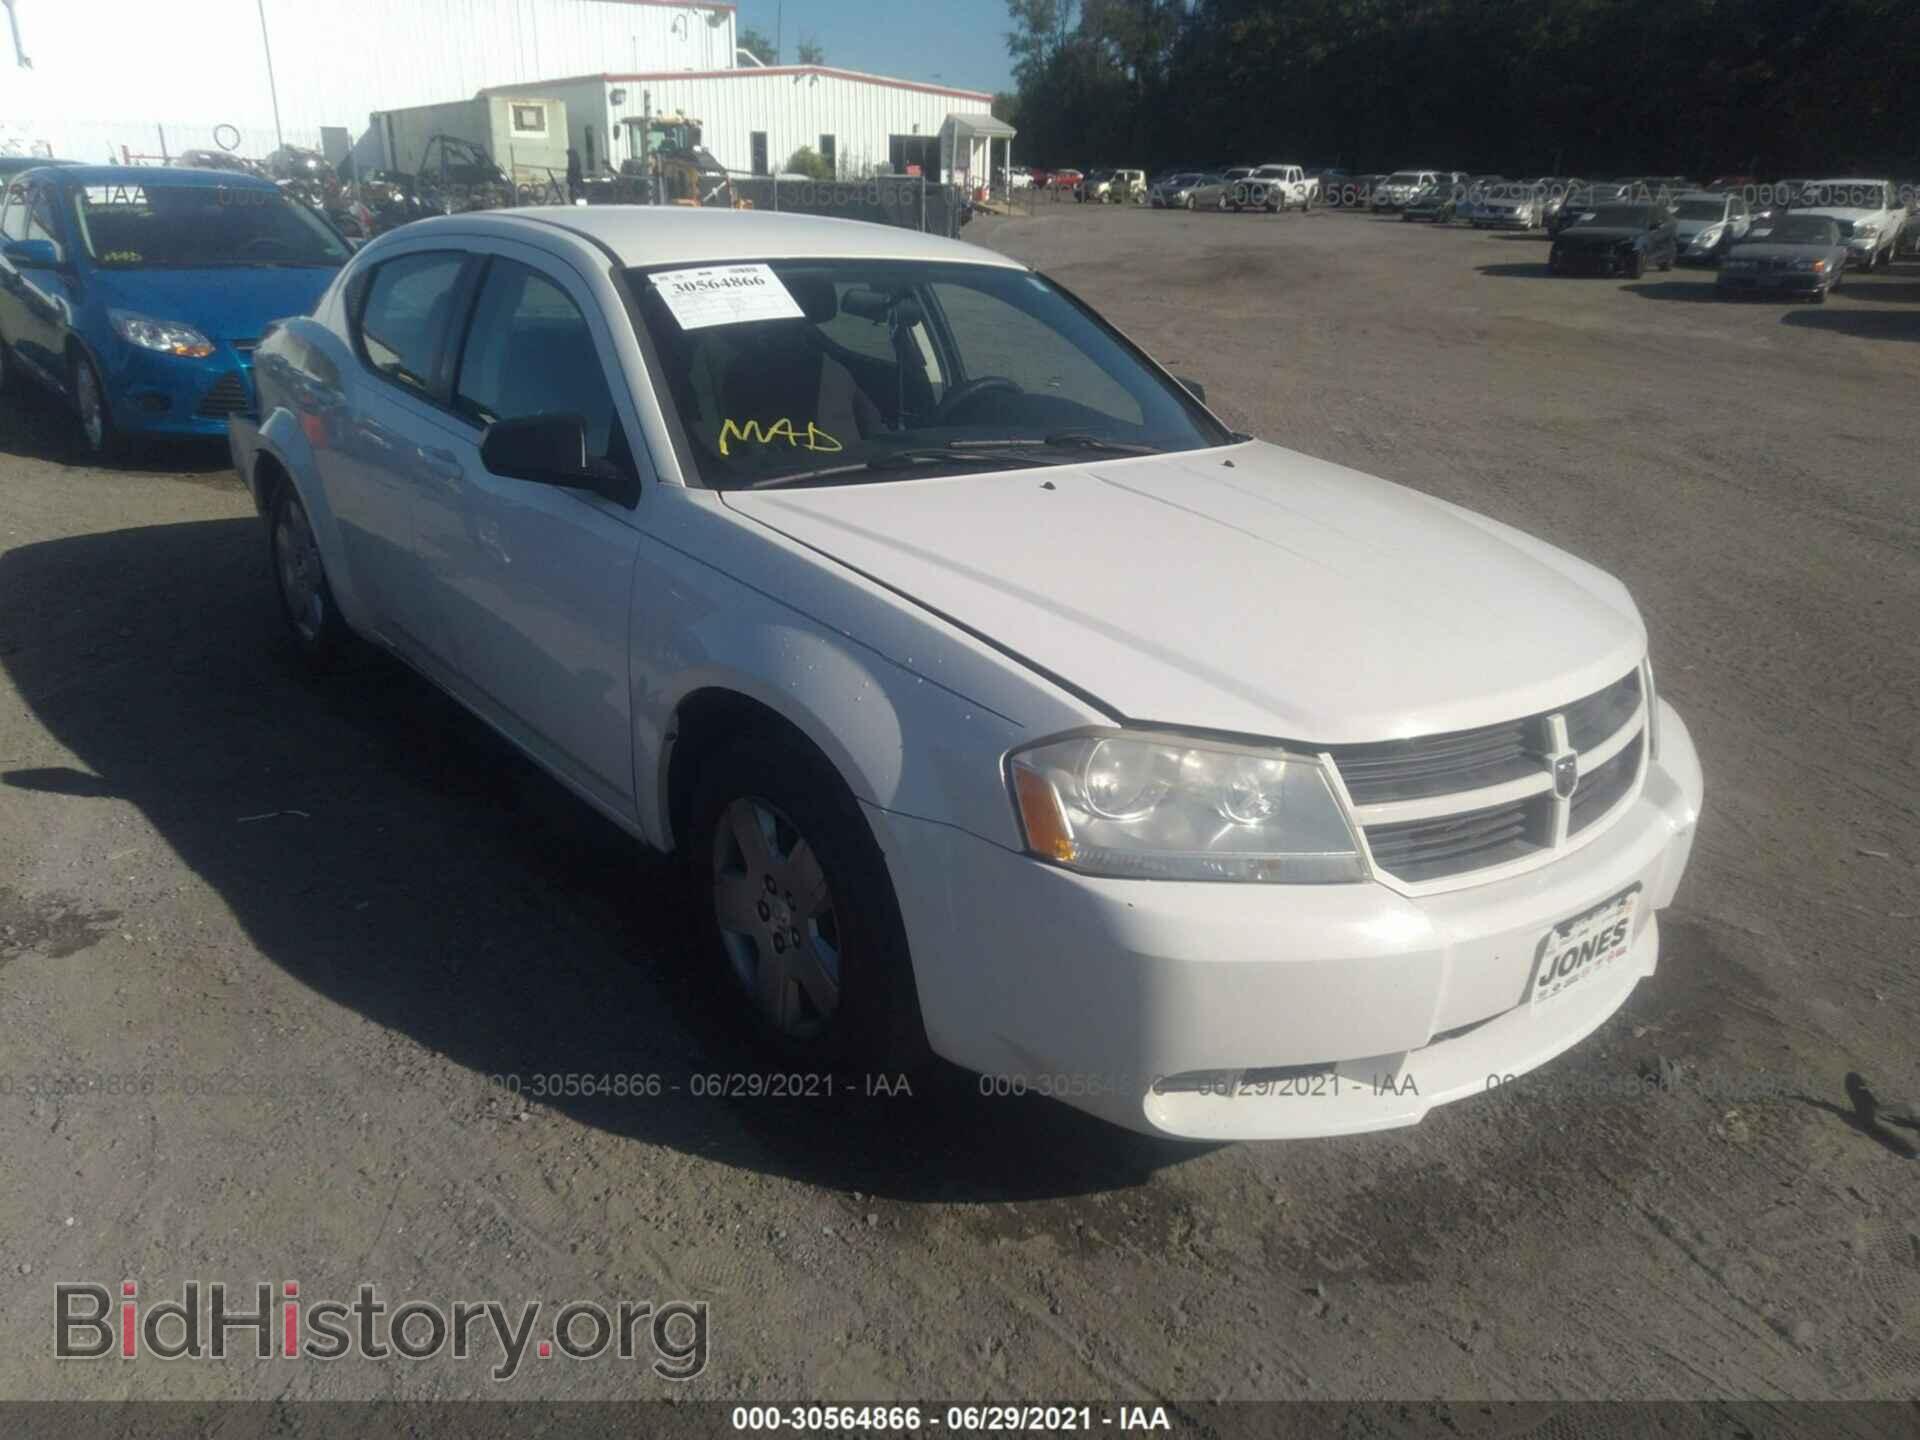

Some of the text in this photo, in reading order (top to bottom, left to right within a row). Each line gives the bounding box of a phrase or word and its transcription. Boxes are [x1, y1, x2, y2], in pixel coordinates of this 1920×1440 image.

[672, 275, 766, 295] 30564866
[719, 417, 843, 456] MAD
[1538, 917, 1629, 987] JONES
